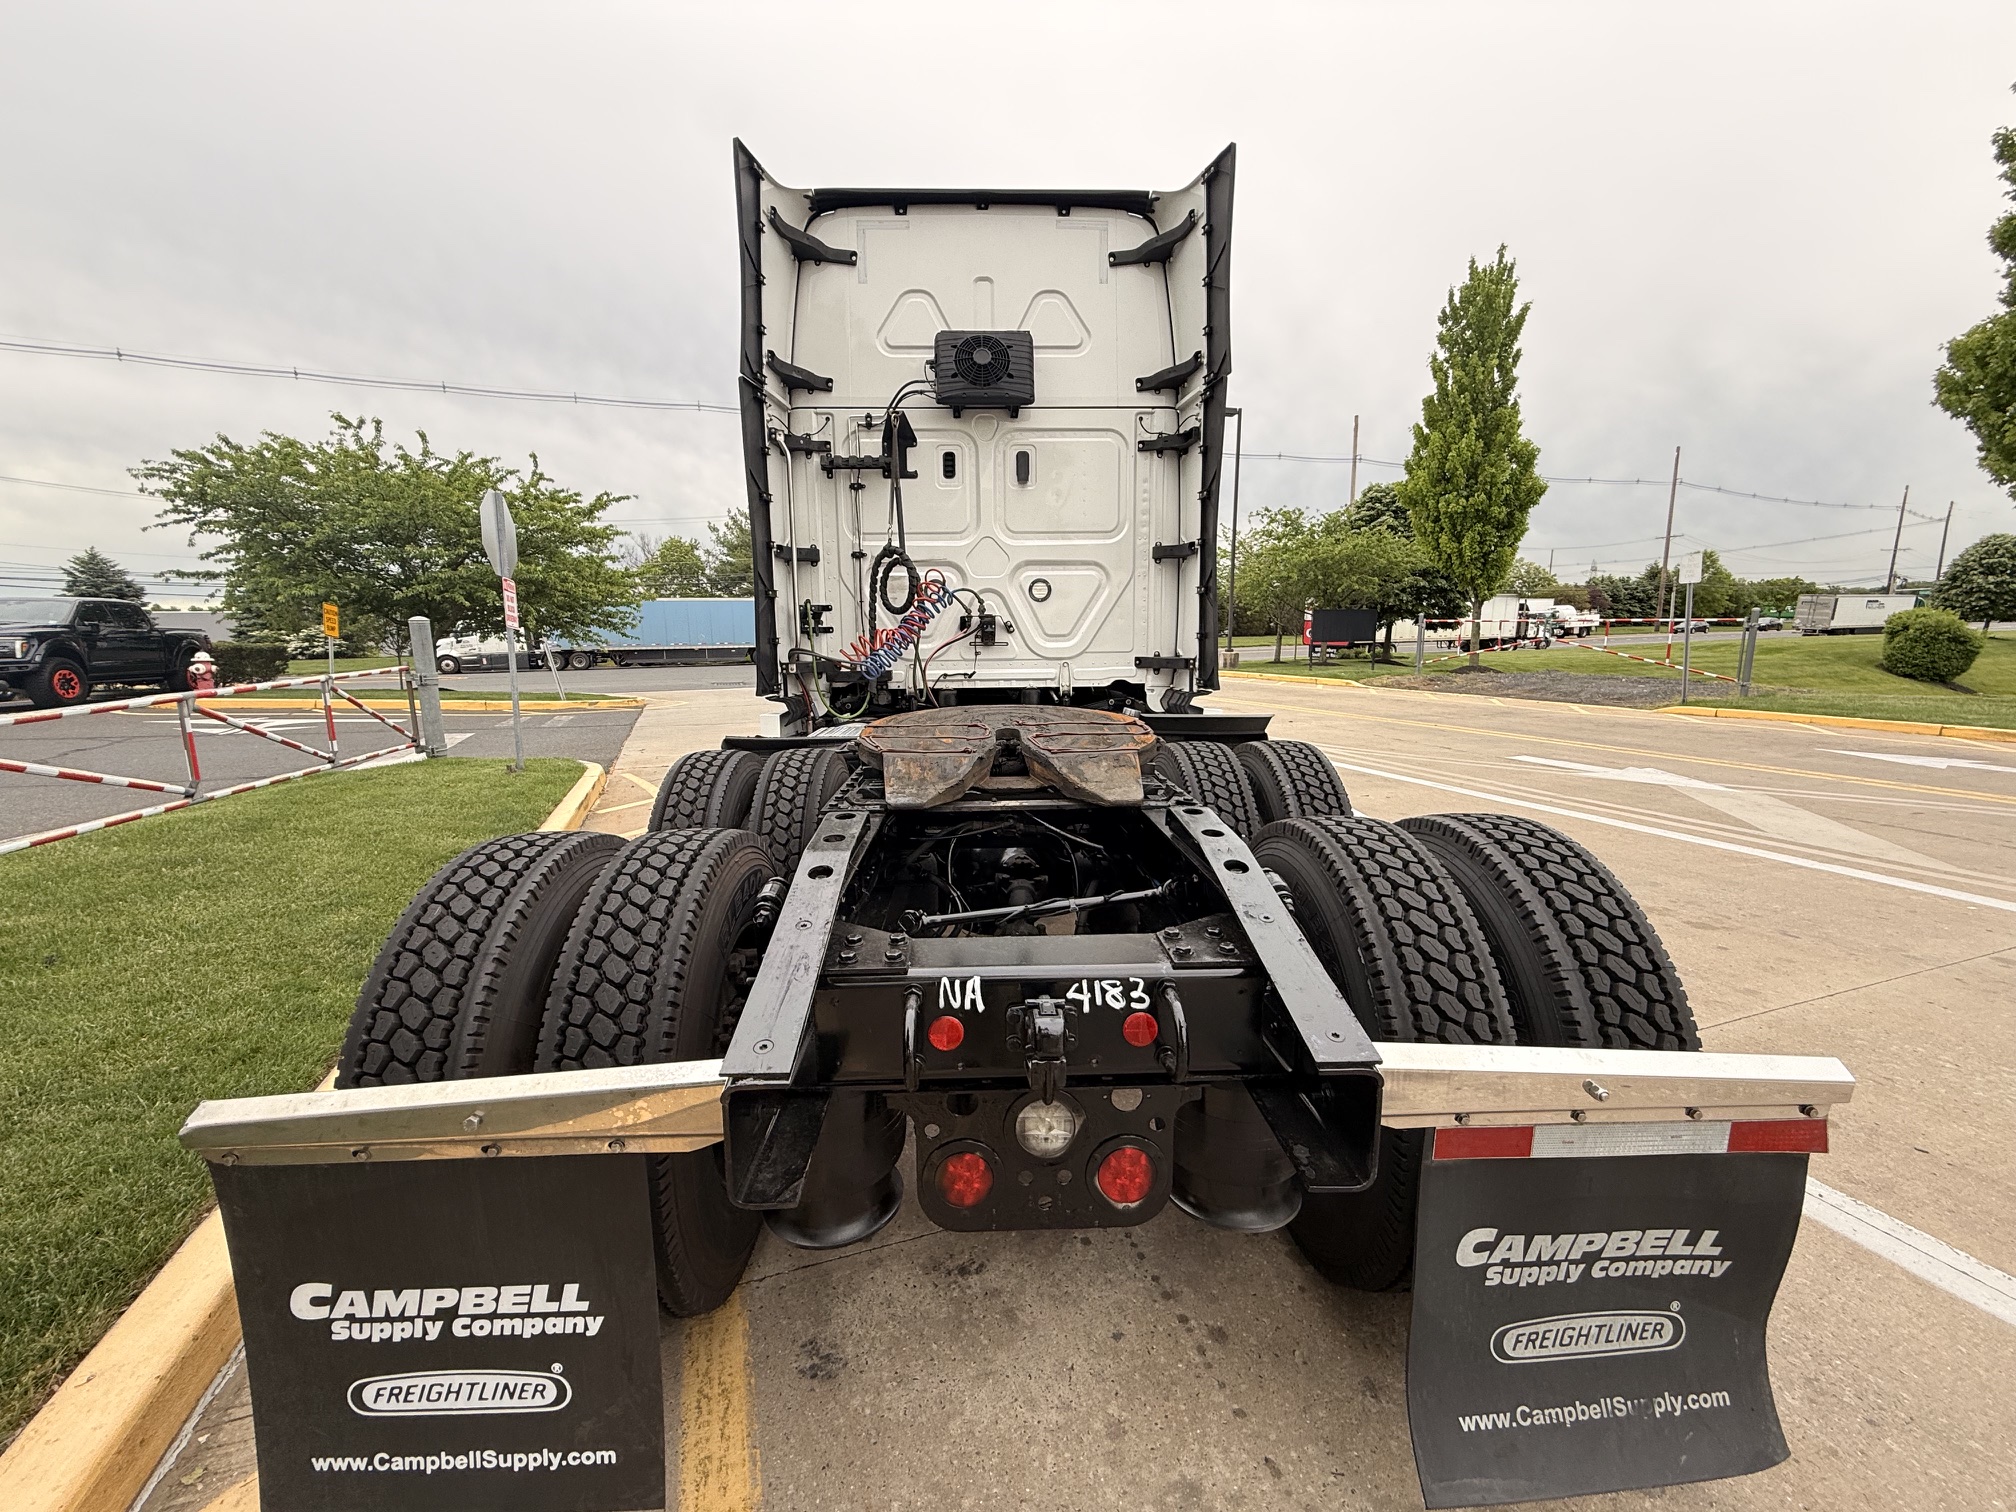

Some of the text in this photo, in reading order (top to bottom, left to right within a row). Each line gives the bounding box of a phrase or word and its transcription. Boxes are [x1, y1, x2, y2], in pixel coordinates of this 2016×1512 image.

[939, 975, 1151, 1013] NA 4183
[1455, 1227, 1723, 1268] CAMPBELL
[1484, 1259, 1733, 1287] Supply Company
[289, 1282, 590, 1321] CAMPBELL
[330, 1315, 605, 1343] Supply Company
[1512, 1322, 1665, 1352] FREIGHTLINER
[373, 1382, 547, 1404] FREIGHTLINER
[310, 1448, 617, 1475] www.CampbellSupply.com
